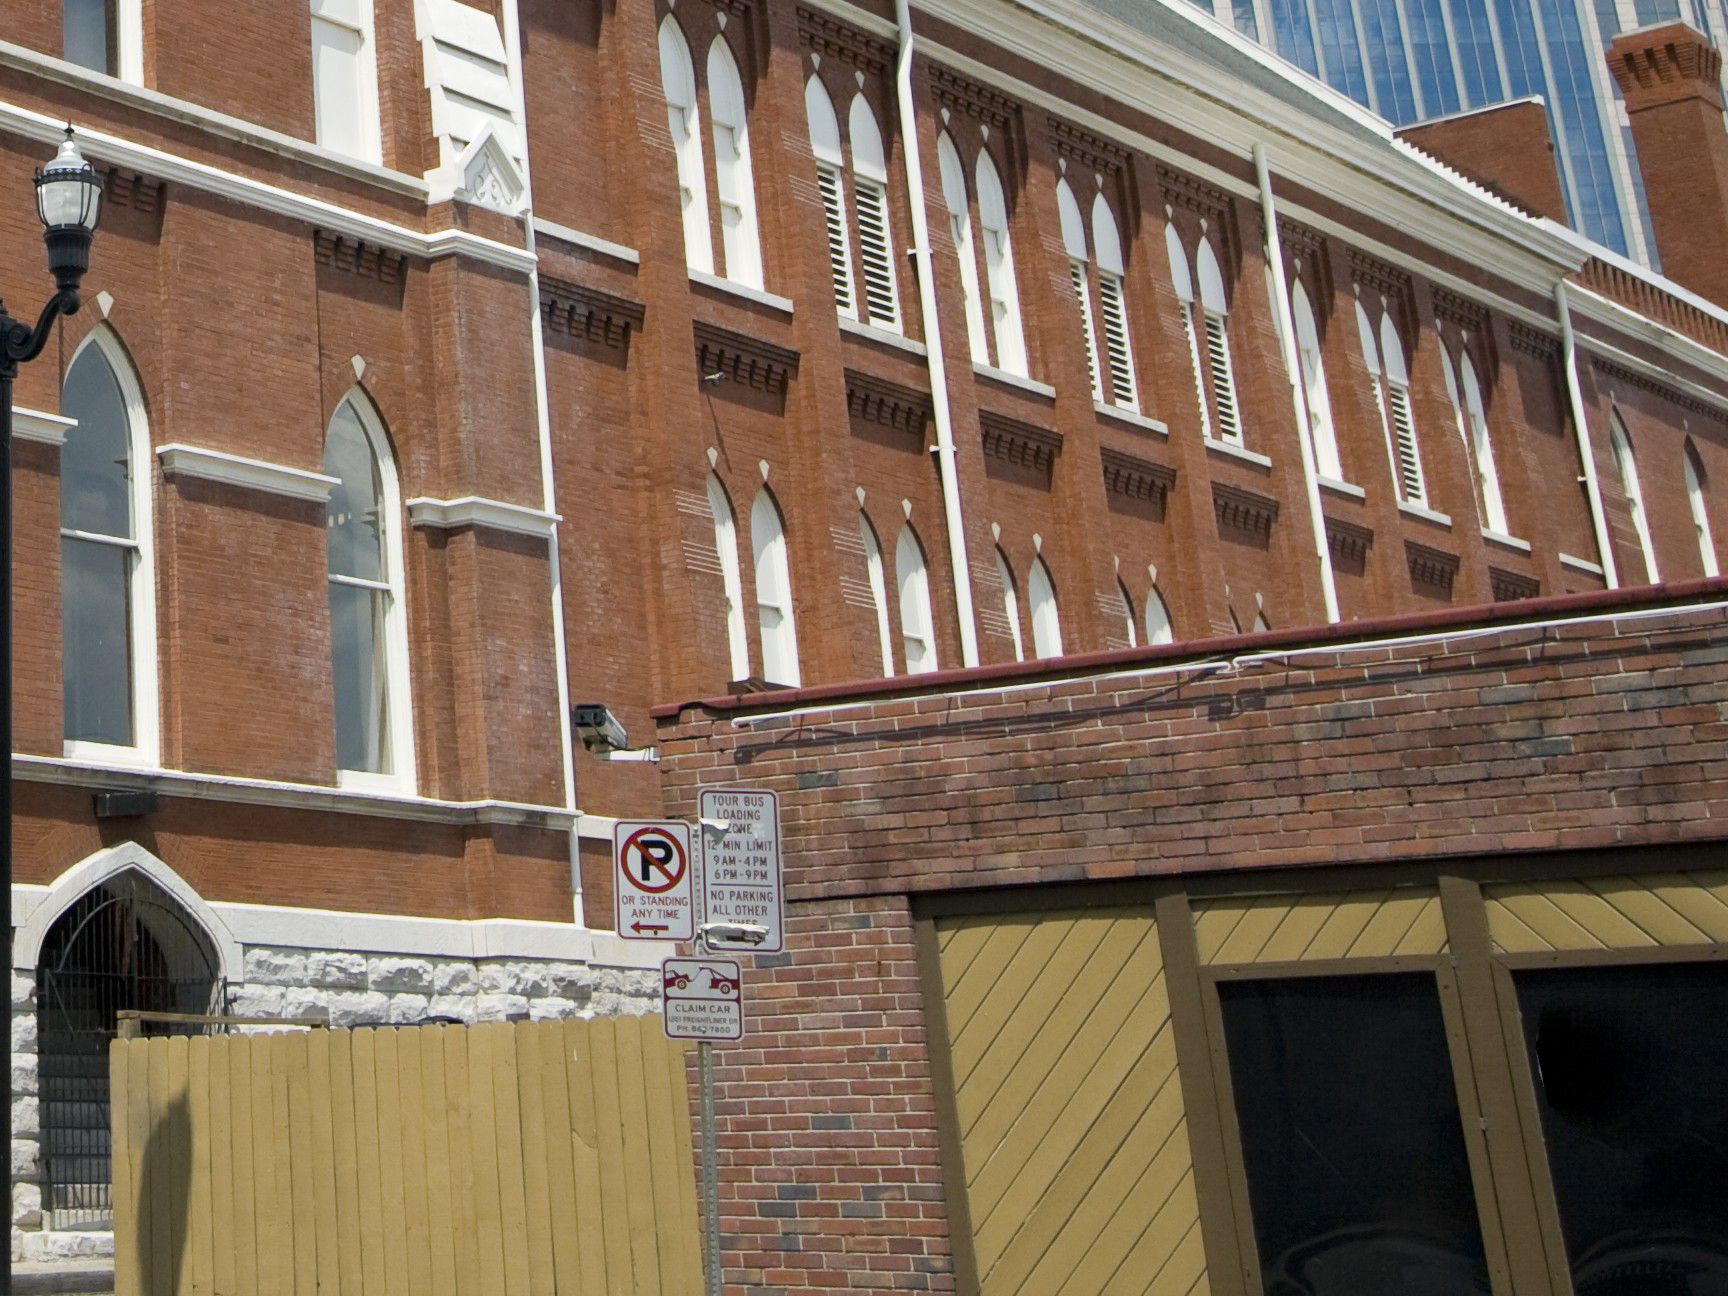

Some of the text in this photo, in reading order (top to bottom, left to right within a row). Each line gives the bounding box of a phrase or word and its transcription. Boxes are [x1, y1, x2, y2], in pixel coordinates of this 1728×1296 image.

[712, 794, 764, 807] TOUR BUS
[716, 809, 761, 821] LOADING
[722, 840, 741, 851] MIN
[746, 840, 773, 852] LIMIT
[621, 895, 689, 907] OR STANDING
[710, 890, 773, 903] NO PARKING
[631, 908, 680, 919] ANY TIME
[712, 904, 768, 916] ALL OTHER
[674, 1004, 731, 1014] CLAIM CAR
